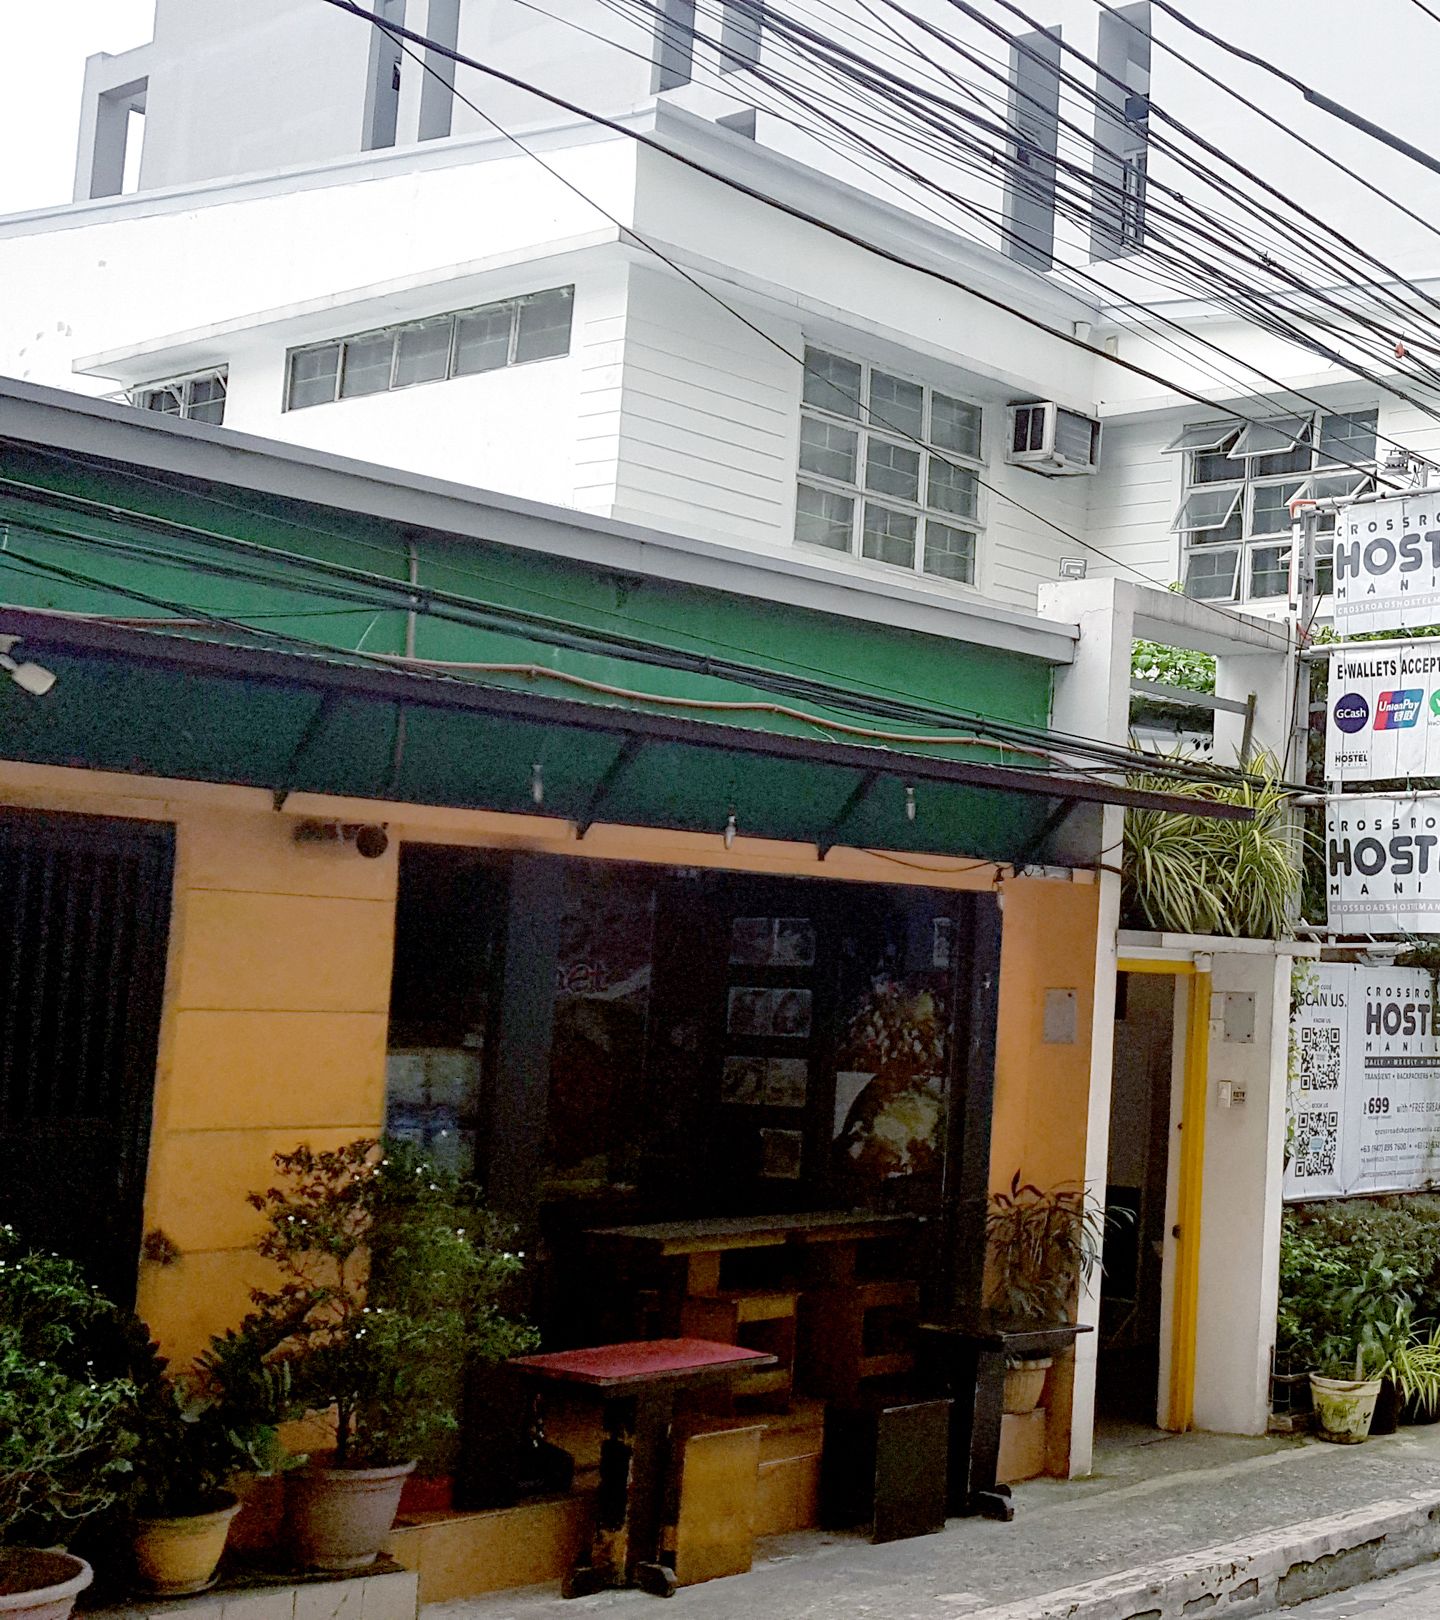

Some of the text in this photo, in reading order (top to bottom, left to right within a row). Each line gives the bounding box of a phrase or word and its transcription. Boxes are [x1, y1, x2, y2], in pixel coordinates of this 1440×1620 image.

[1336, 707, 1367, 719] GCash
[1378, 698, 1420, 713] UnionPay
[1335, 754, 1367, 763] HOSTEL
[1297, 992, 1347, 1008] SCAN US.
[1369, 1097, 1389, 1114] 699
